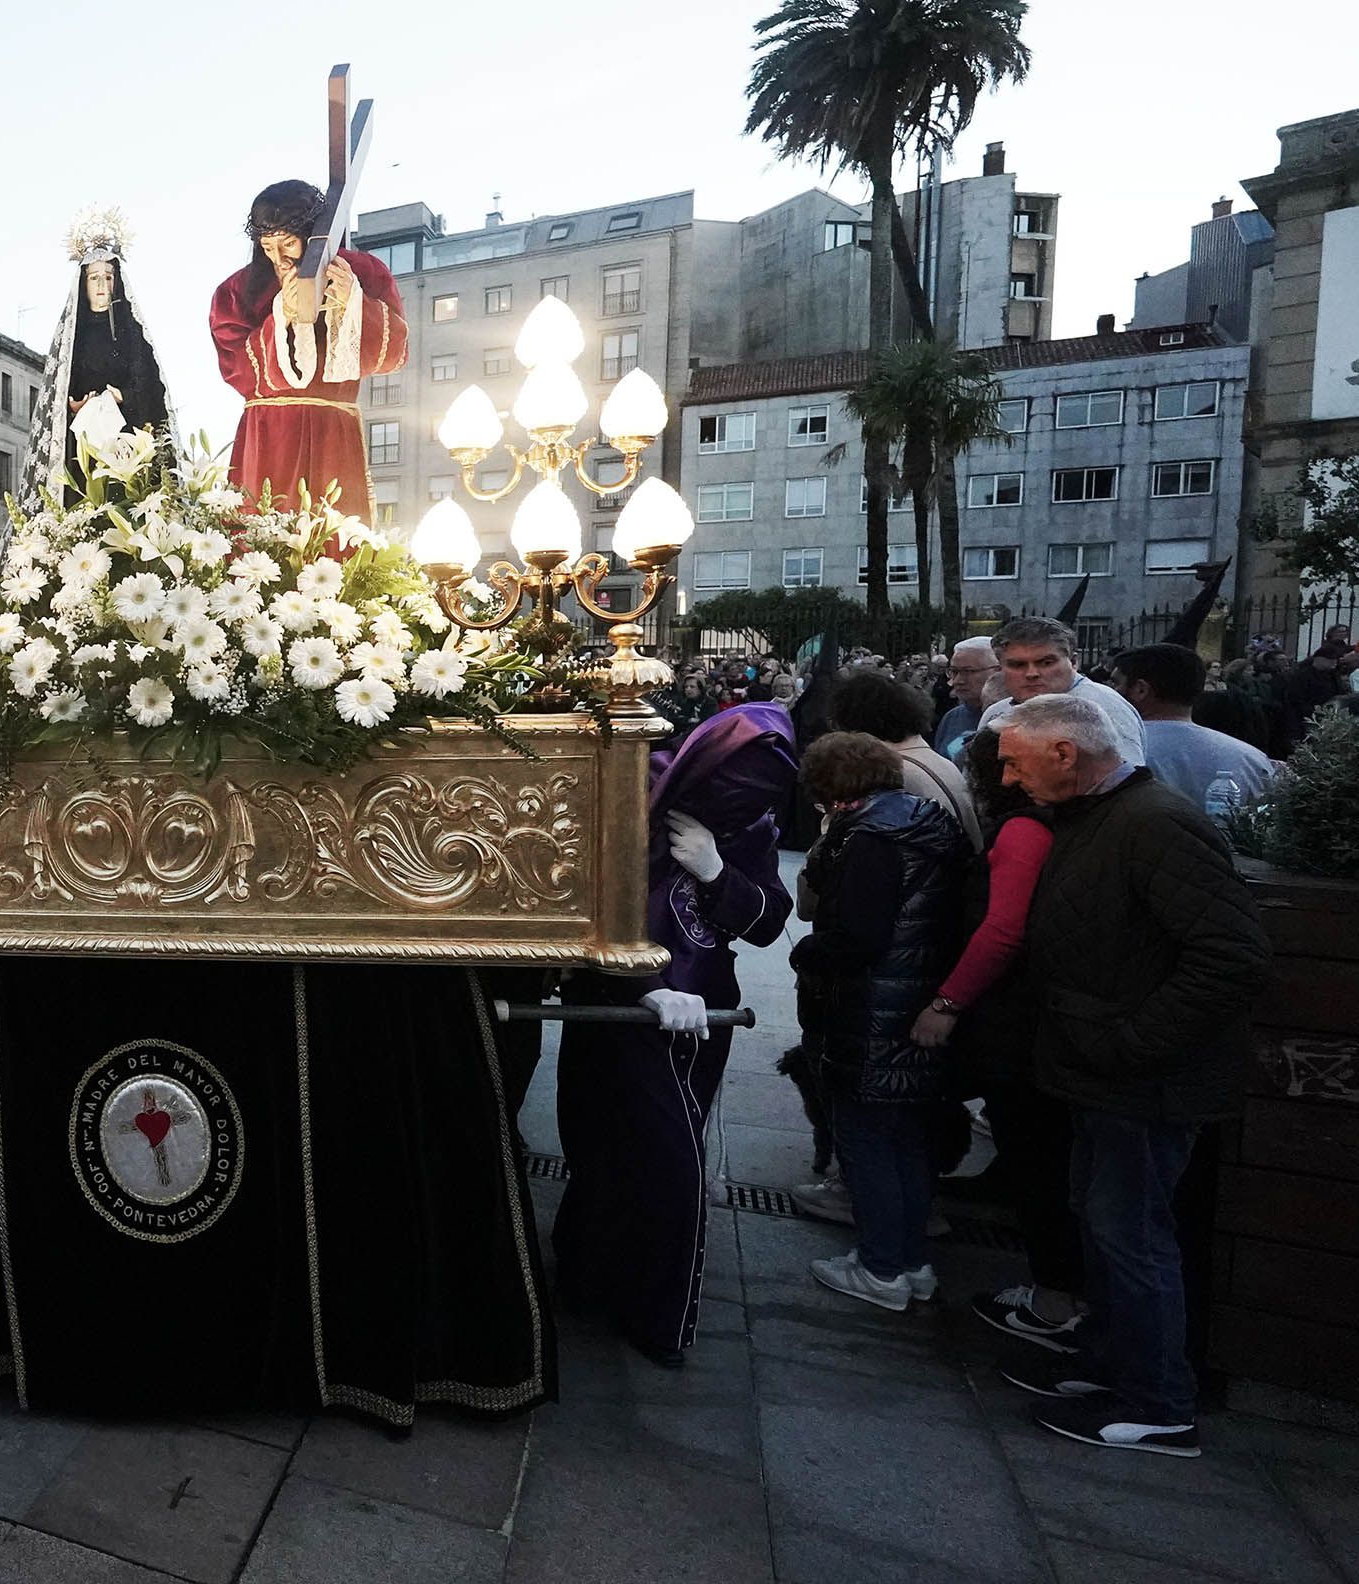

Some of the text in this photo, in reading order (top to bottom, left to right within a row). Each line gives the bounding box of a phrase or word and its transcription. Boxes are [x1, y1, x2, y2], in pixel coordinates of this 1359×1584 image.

[127, 1054, 162, 1069] DEL
[173, 1060, 221, 1107] MAYOR
[216, 1119, 230, 1183] DOLOR
[113, 1194, 216, 1227] PONTEVEDRA
